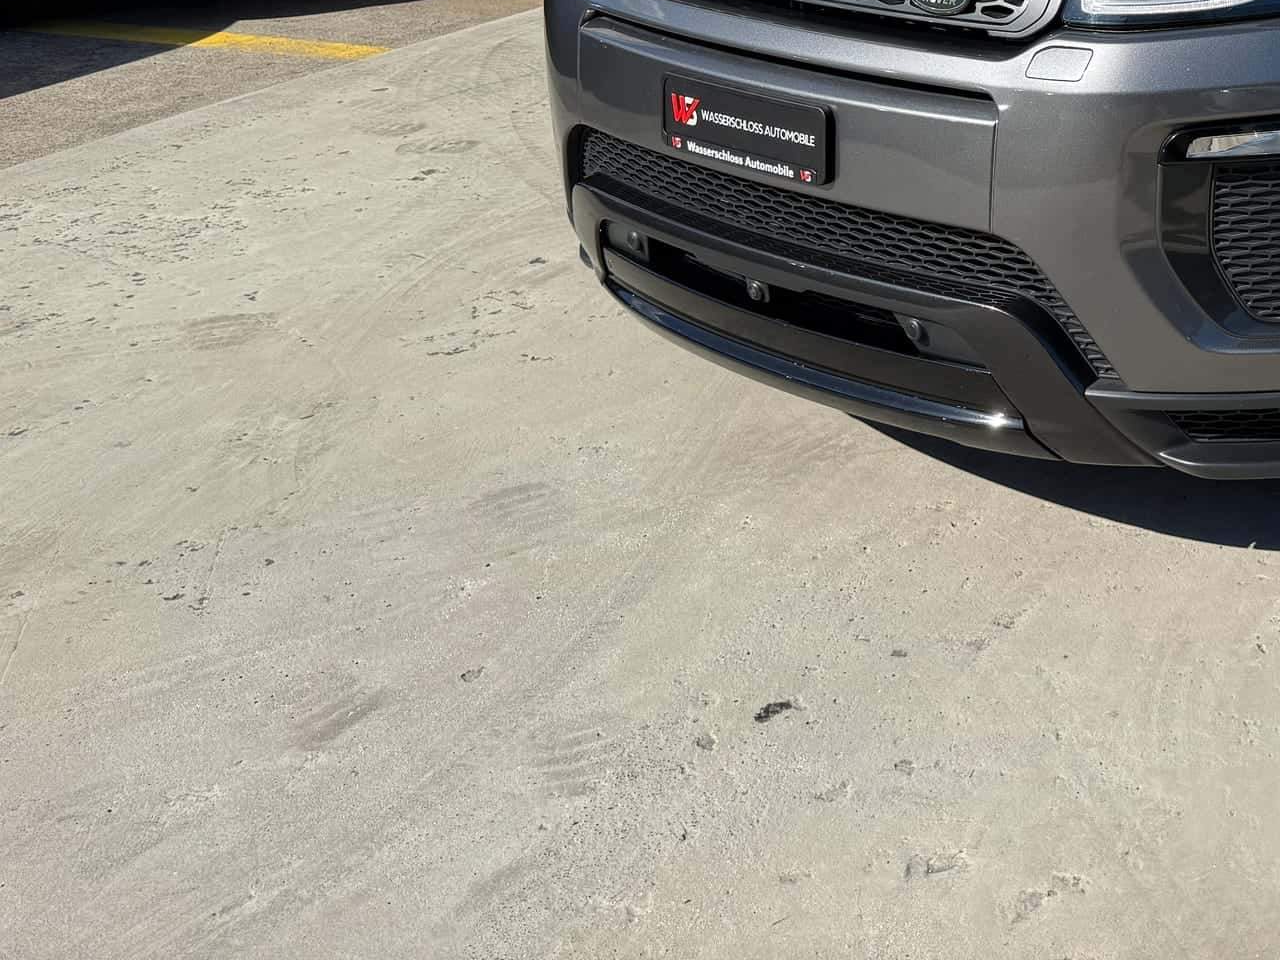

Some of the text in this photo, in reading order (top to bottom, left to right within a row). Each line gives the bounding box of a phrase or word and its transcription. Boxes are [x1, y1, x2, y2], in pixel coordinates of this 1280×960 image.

[701, 109, 764, 134] WASSERSCHLOSS
[764, 125, 816, 147] AUTOMOBILE
[687, 140, 744, 165] Wasserschloss
[744, 157, 795, 178] Automobile
